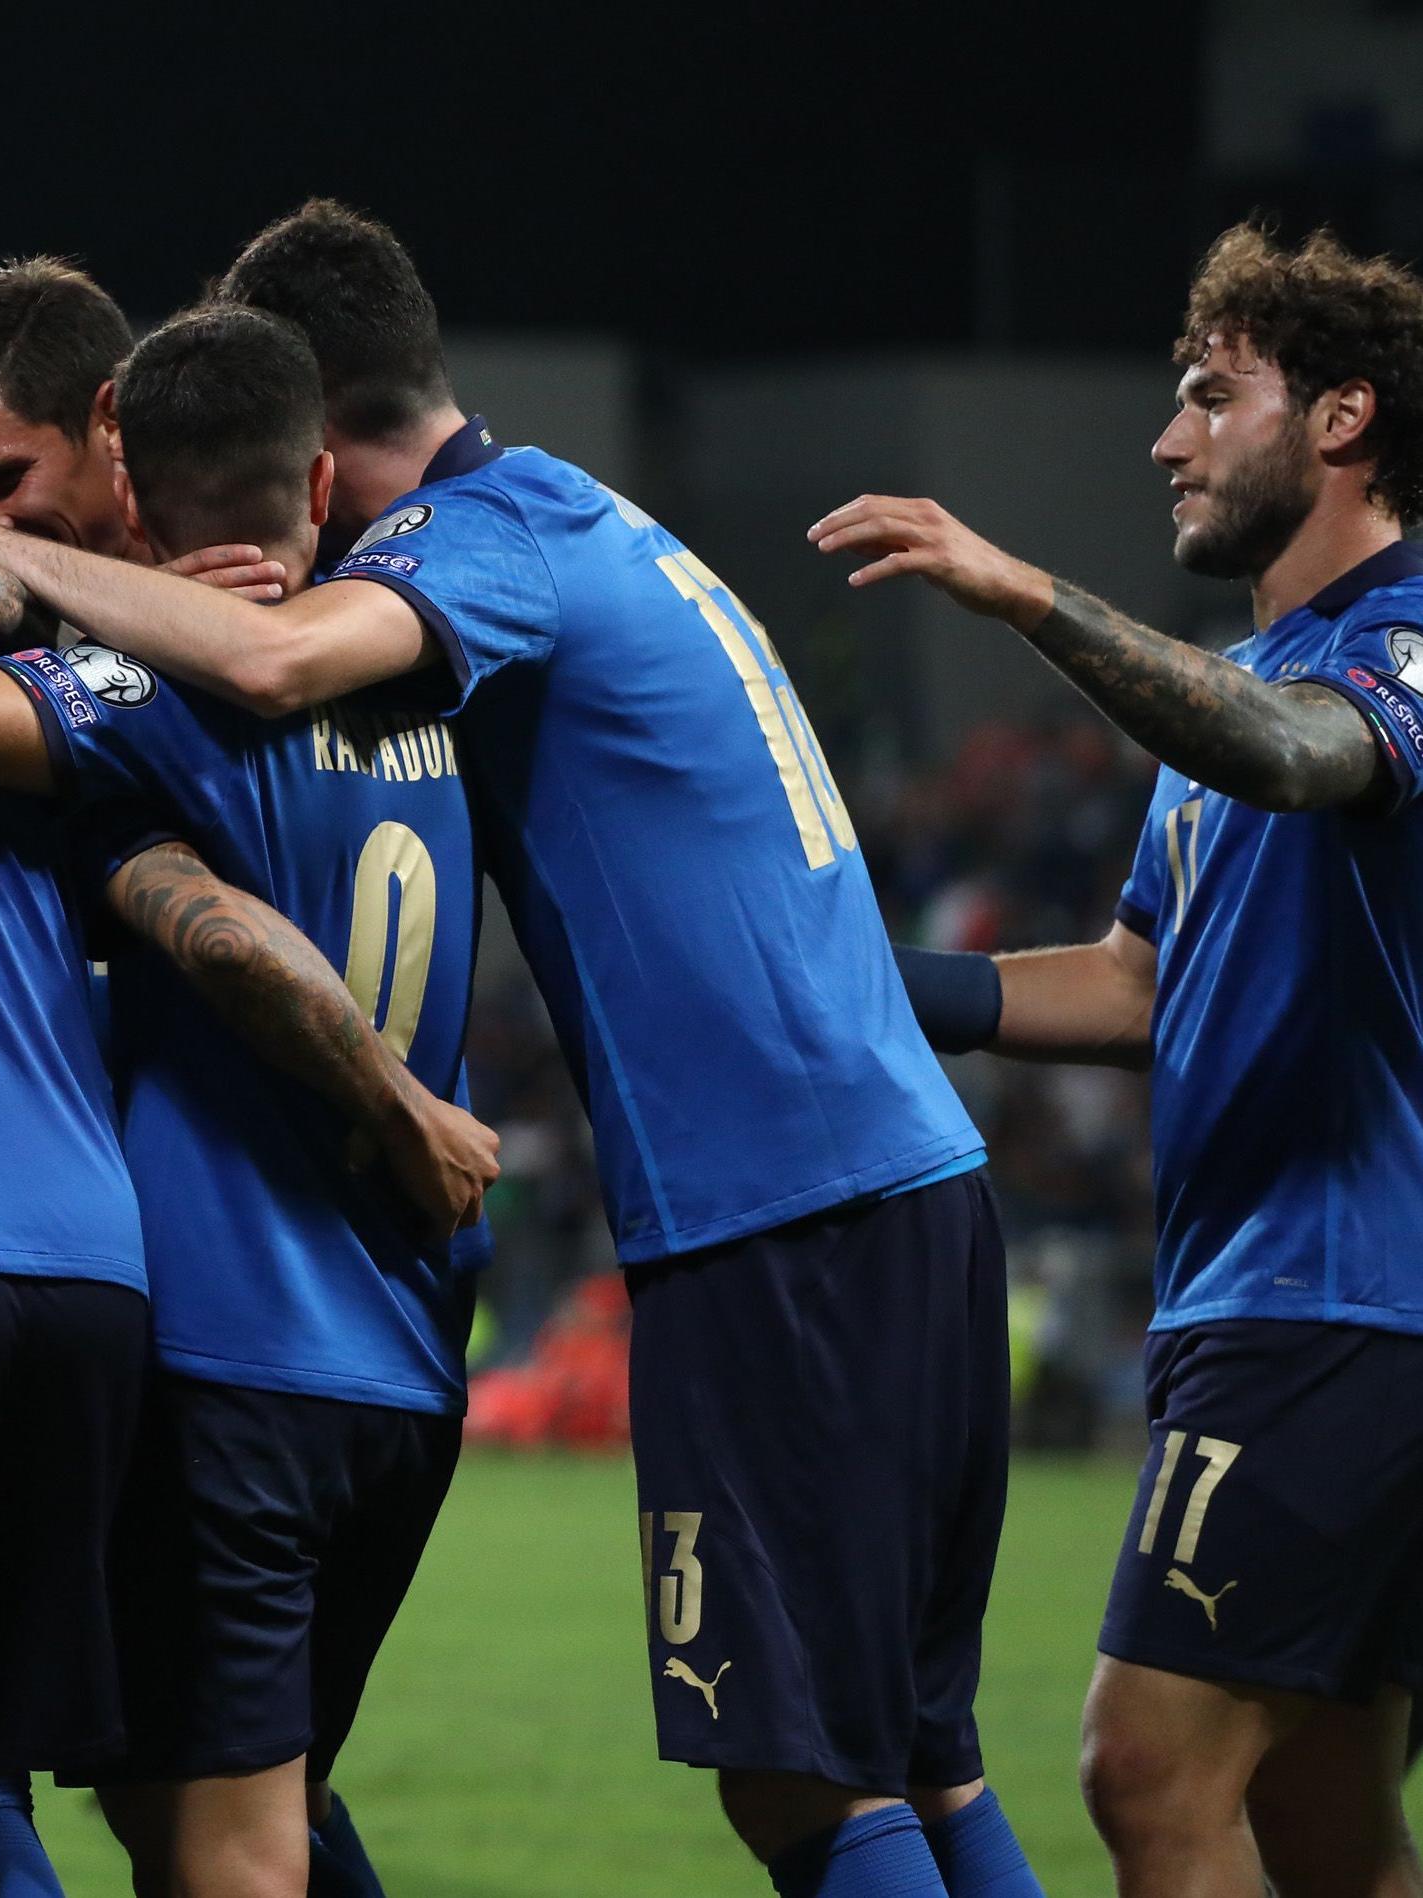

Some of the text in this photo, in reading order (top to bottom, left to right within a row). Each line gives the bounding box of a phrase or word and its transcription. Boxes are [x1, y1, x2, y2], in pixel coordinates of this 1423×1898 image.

[33, 656, 94, 726] RESPECT
[1376, 686, 1423, 756] RESPEC
[1138, 1430, 1243, 1565] 17
